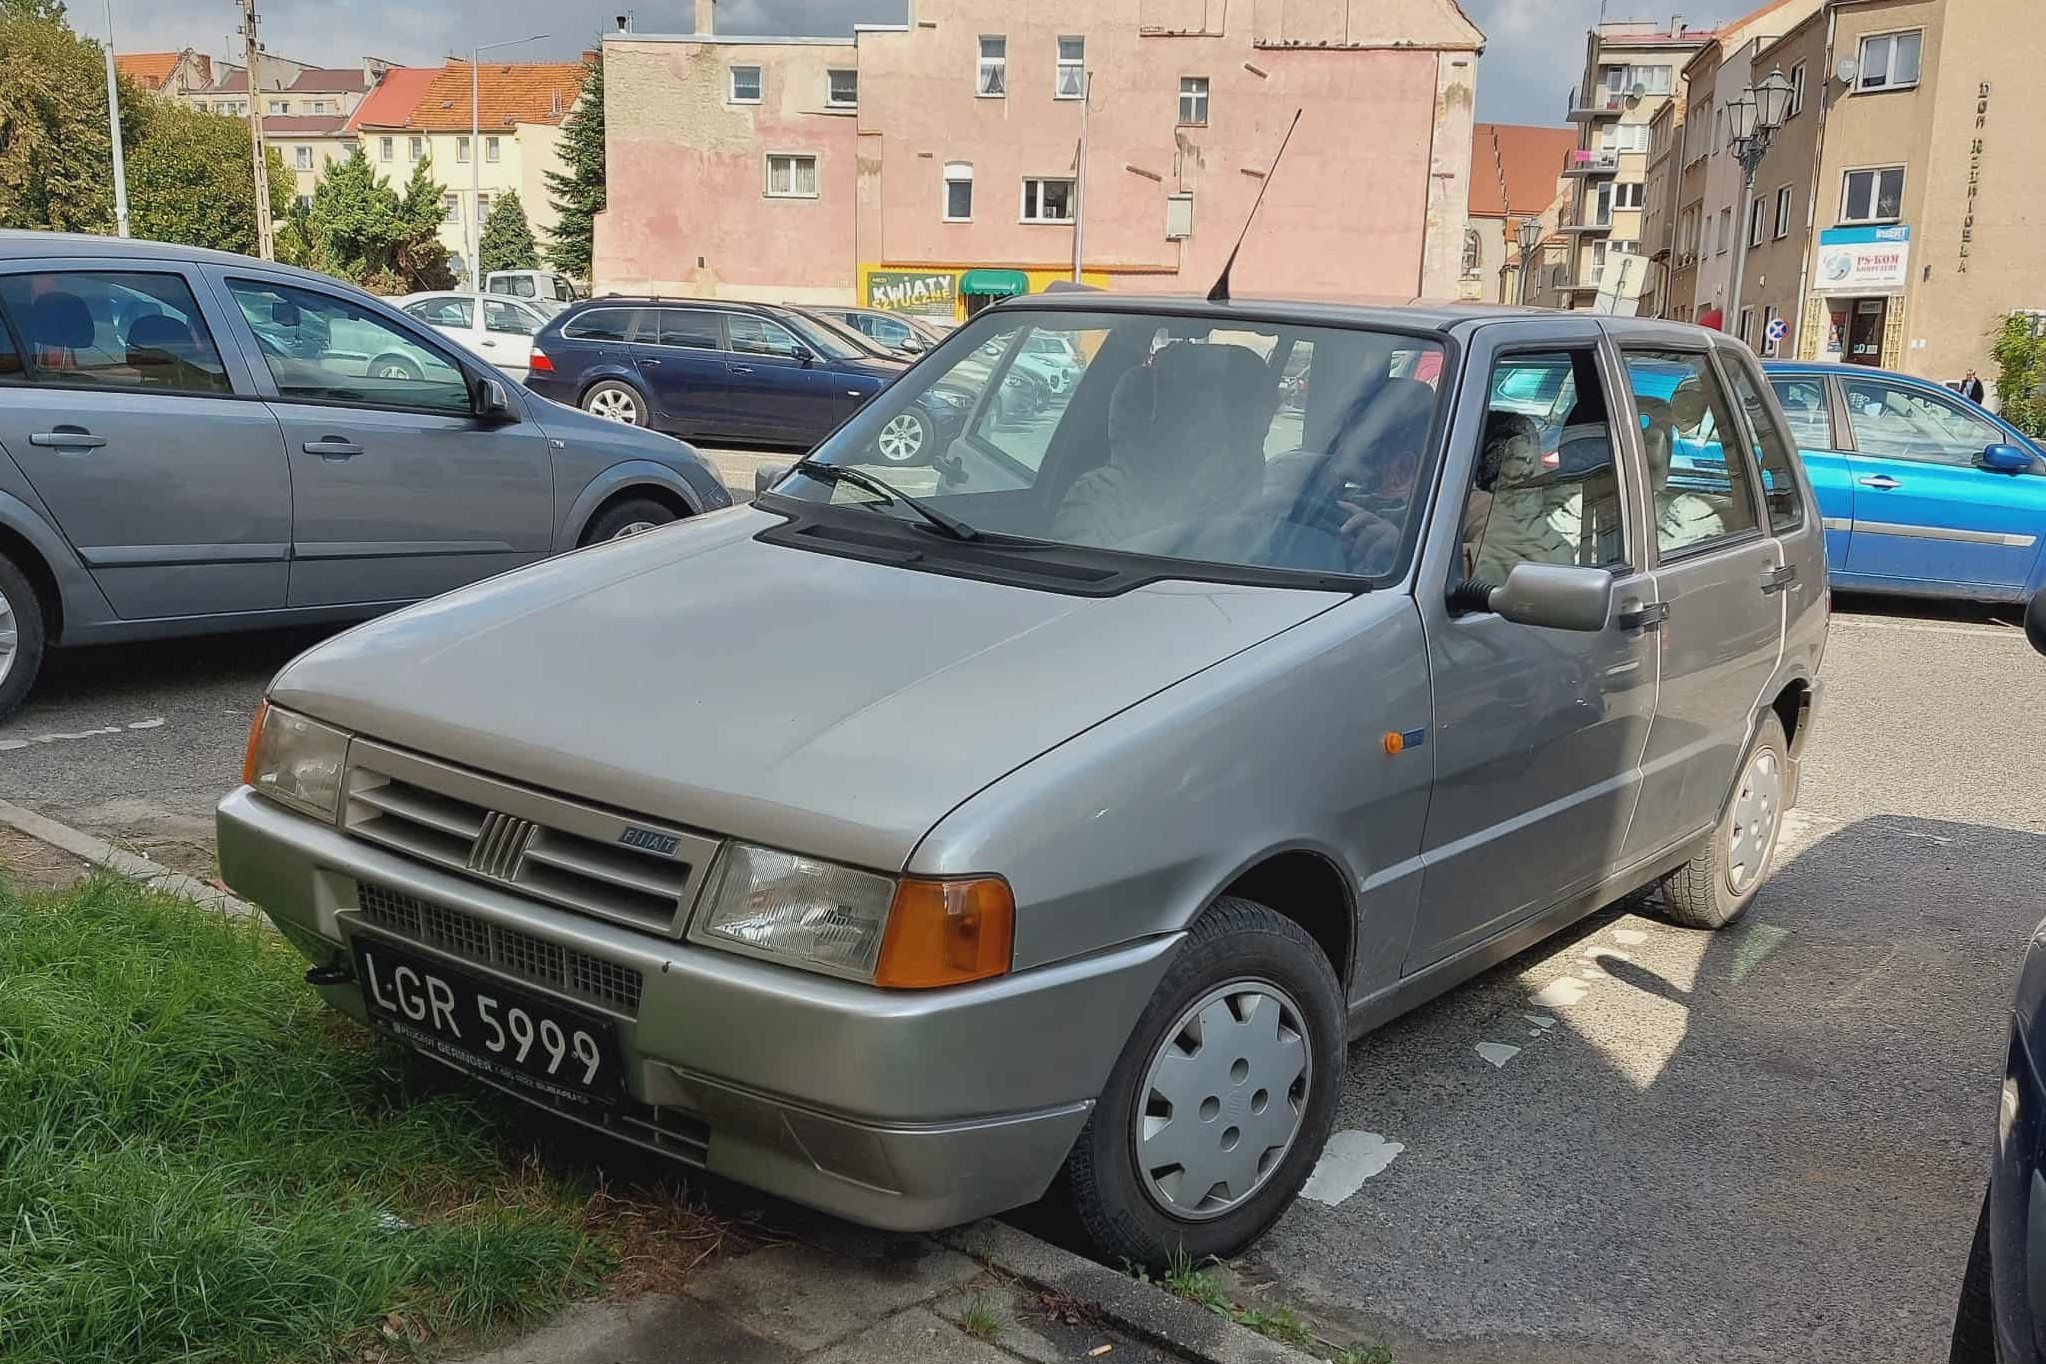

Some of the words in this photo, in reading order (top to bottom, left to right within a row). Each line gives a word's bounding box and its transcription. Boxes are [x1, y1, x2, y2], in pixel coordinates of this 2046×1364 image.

[1857, 254, 1899, 265] PS-KOM
[622, 829, 677, 851] FIAT
[366, 953, 461, 1038] LGR
[478, 995, 600, 1085] 5999
